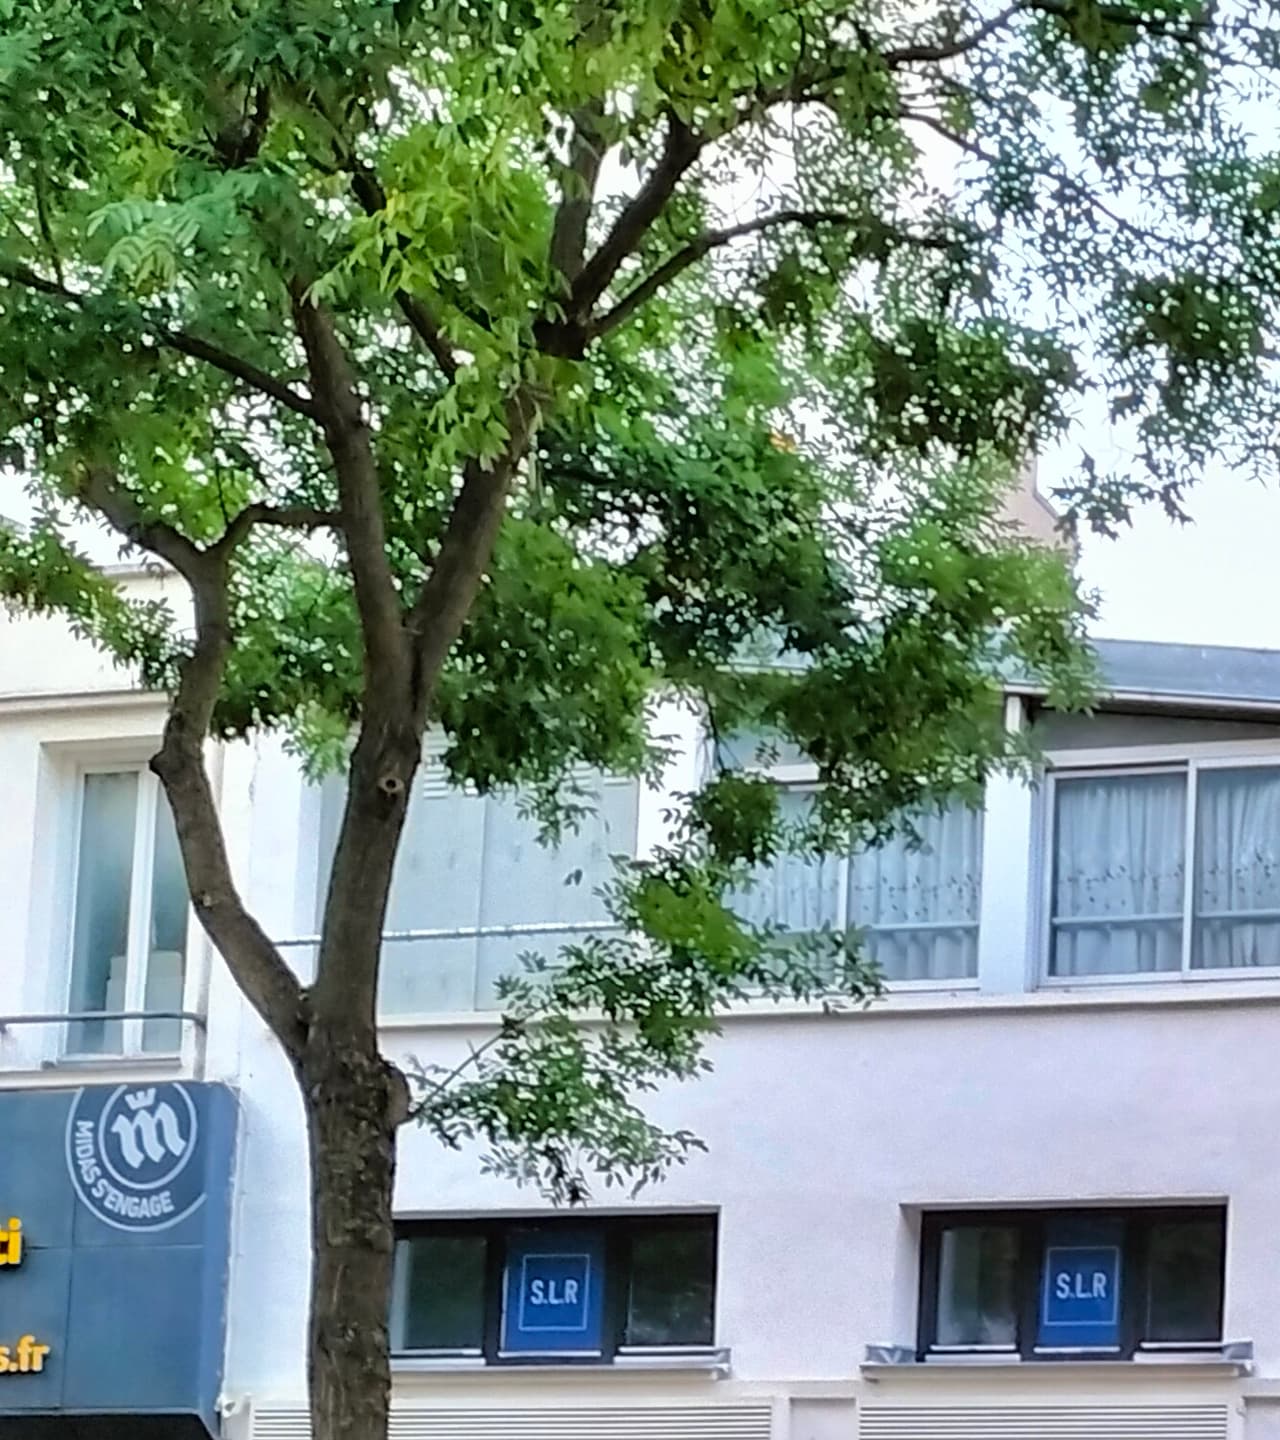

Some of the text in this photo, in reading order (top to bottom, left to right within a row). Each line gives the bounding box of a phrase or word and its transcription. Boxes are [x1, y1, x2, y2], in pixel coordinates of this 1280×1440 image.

[75, 1120, 102, 1184] MIDAS
[530, 1279, 579, 1305] S.L.R
[1055, 1272, 1107, 1299] S.L.R
